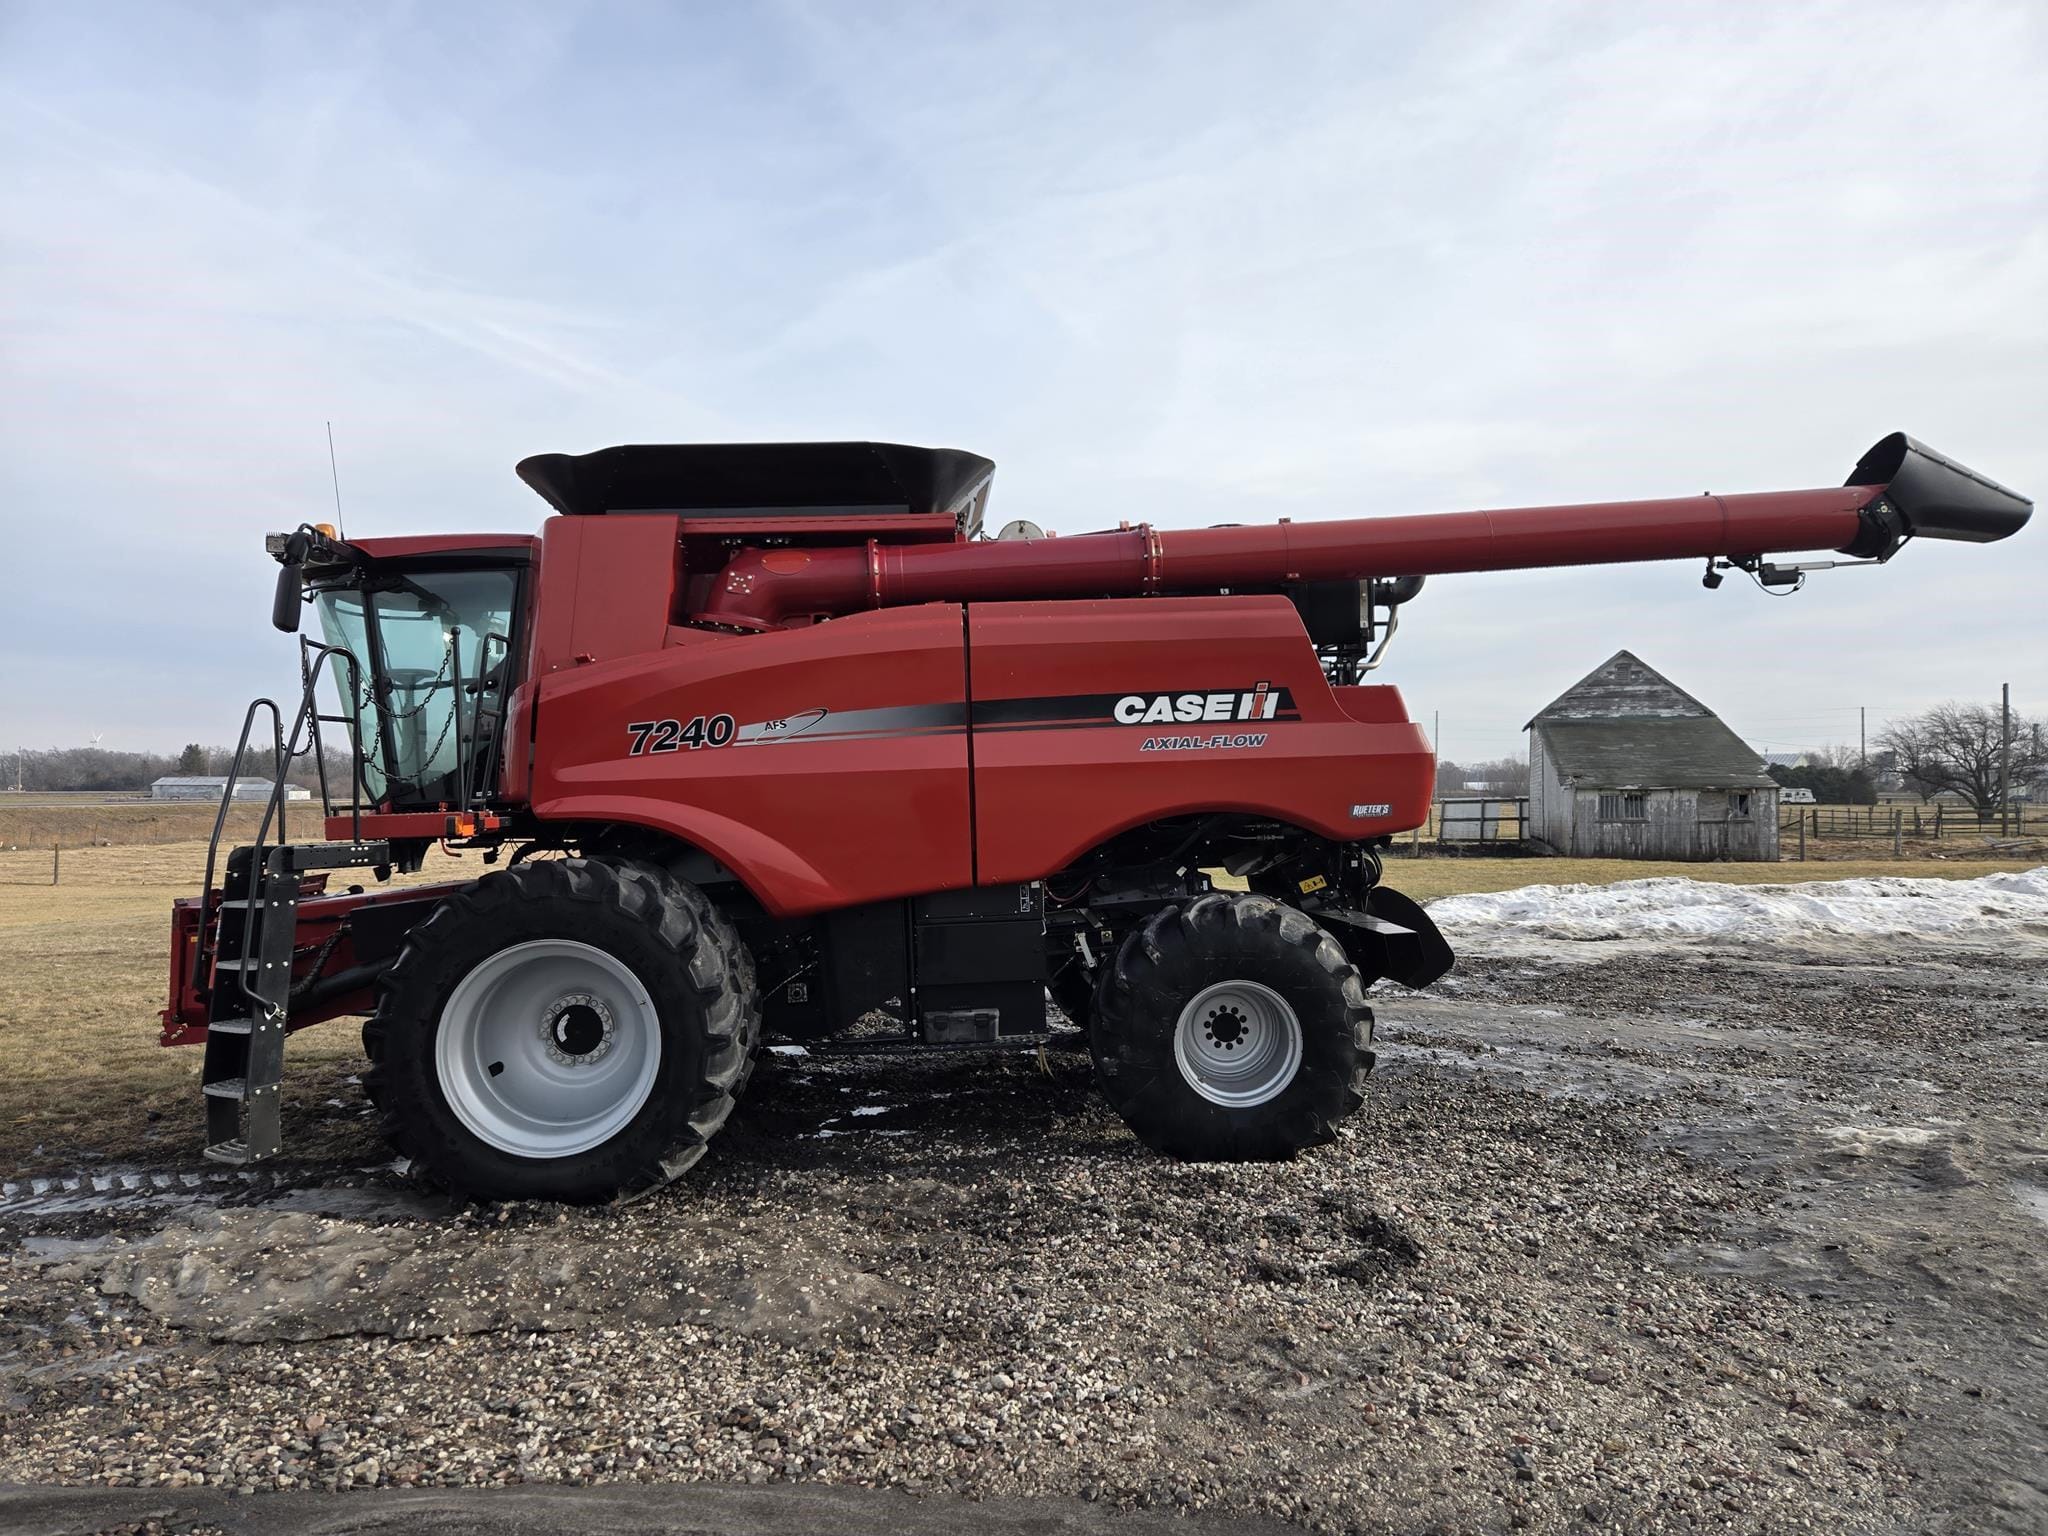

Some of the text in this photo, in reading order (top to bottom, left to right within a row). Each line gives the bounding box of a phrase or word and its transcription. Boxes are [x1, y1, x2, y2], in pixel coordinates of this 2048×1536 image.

[1114, 694, 1235, 724] CASE
[764, 719, 787, 731] AFS
[628, 713, 735, 756] 7240
[1140, 734, 1267, 751] AXIAL-FLOW
[1352, 804, 1389, 816] RUETER'S
